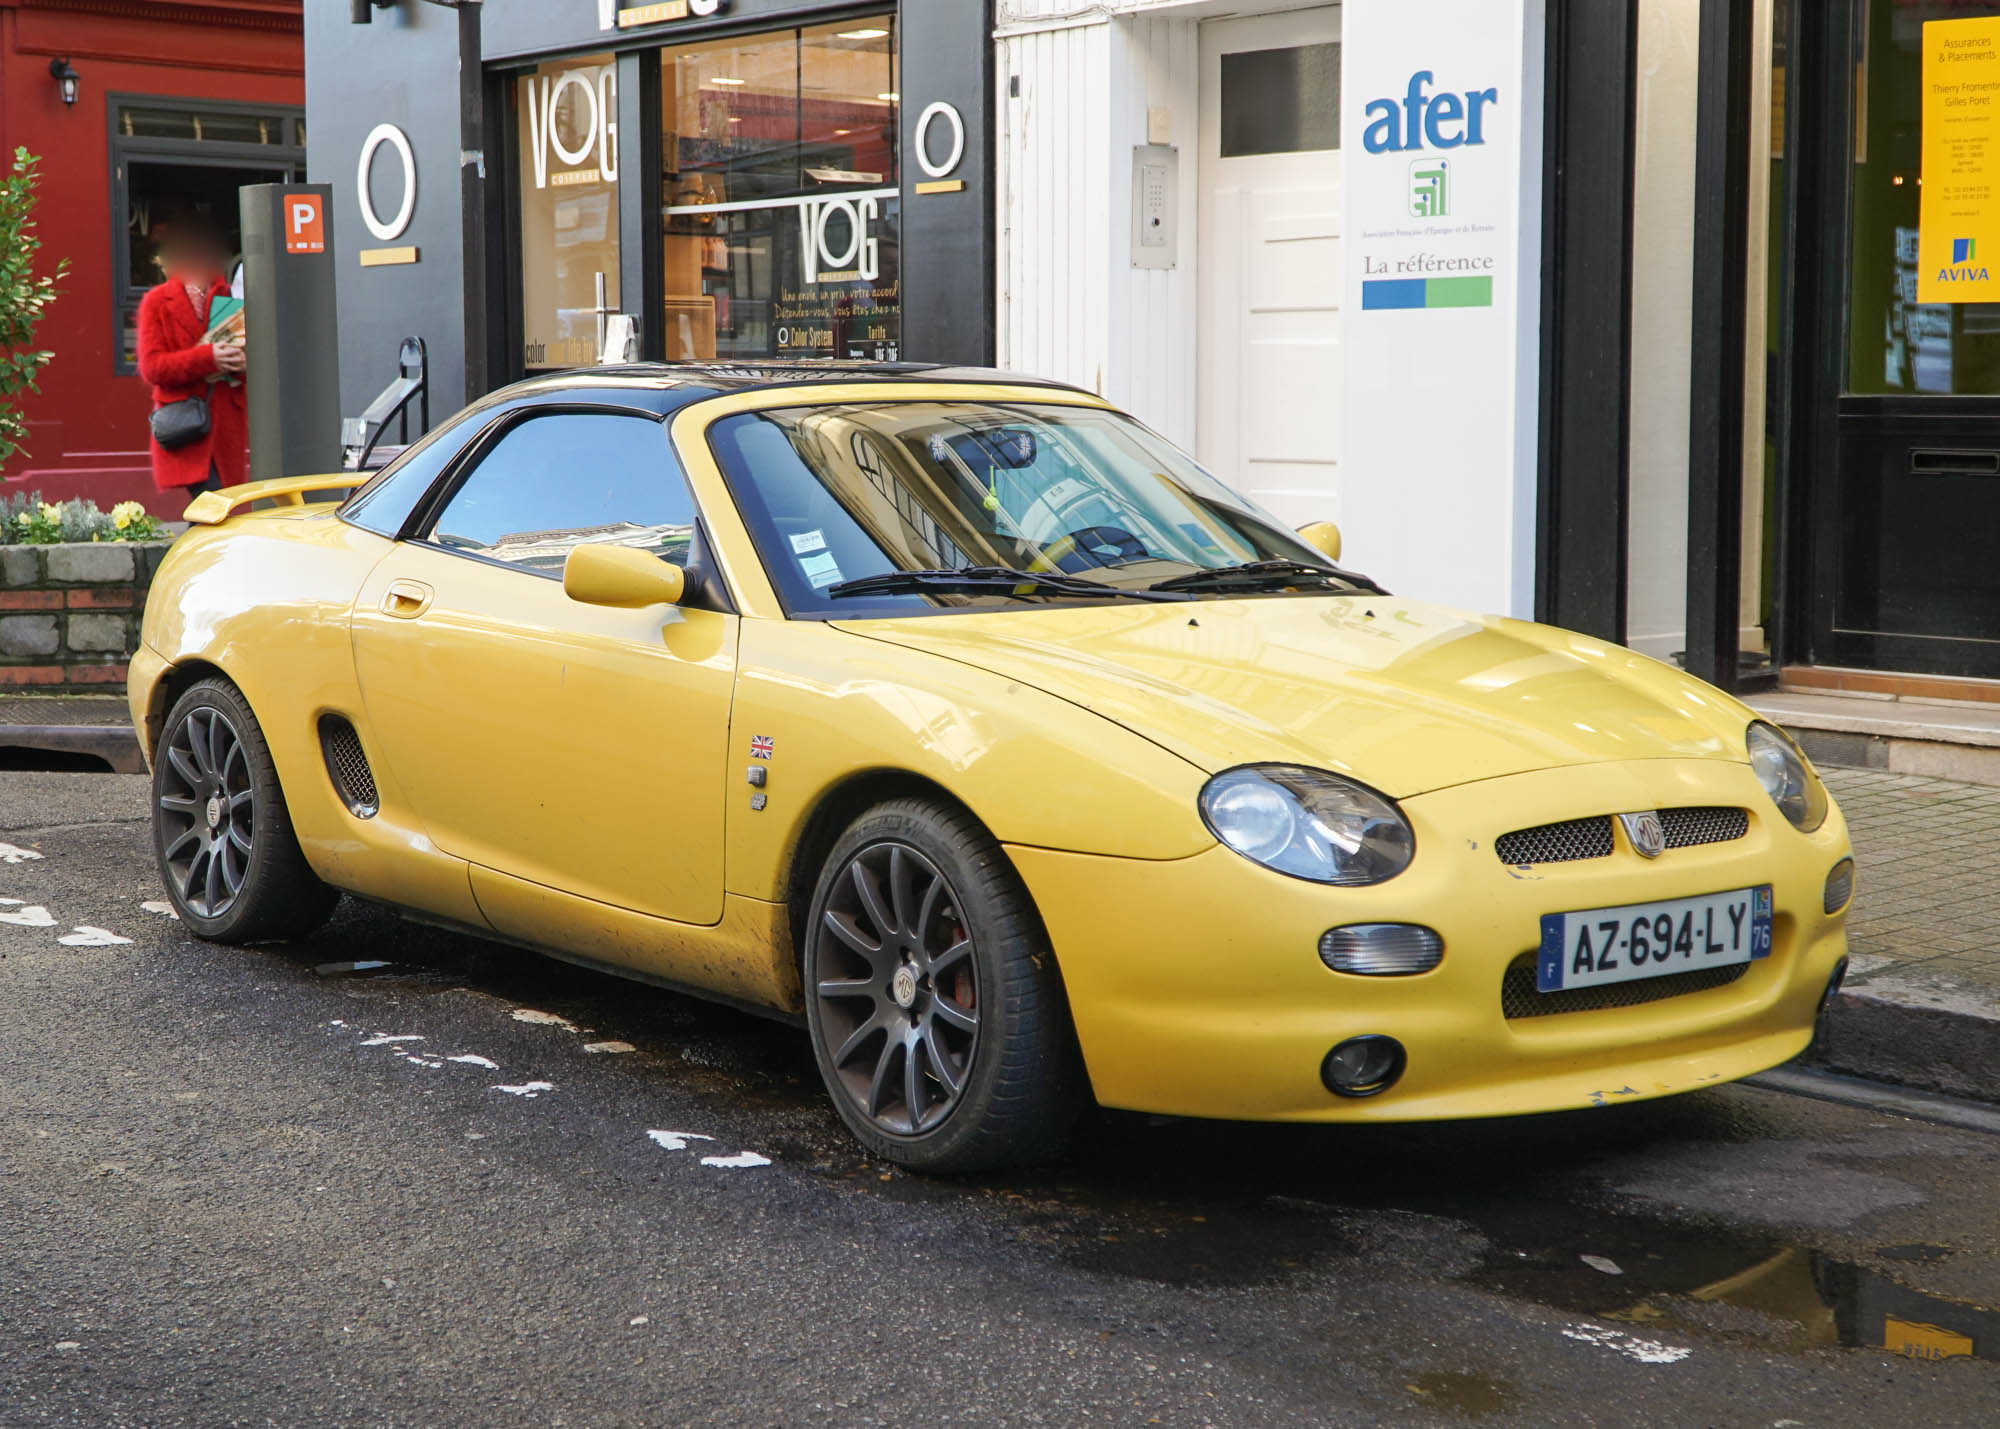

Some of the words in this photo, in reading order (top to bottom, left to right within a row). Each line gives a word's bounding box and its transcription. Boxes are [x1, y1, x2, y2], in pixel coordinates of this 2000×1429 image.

[1943, 38, 1991, 48] Assurances
[1948, 50, 1996, 62] Placements
[1933, 84, 1960, 94] Thierry
[1363, 70, 1497, 155] afer
[528, 63, 617, 189] VOG
[293, 204, 315, 234] P
[799, 198, 879, 284] VOG
[1364, 256, 1388, 274] La
[1397, 253, 1494, 273] référence
[1937, 267, 1990, 281] AVIVA
[526, 338, 546, 363] color
[809, 327, 833, 349] System
[1638, 817, 1662, 849] MG
[1572, 902, 1747, 975] AZ-694-LY
[1753, 924, 1770, 950] 76
[1547, 963, 1556, 978] F
